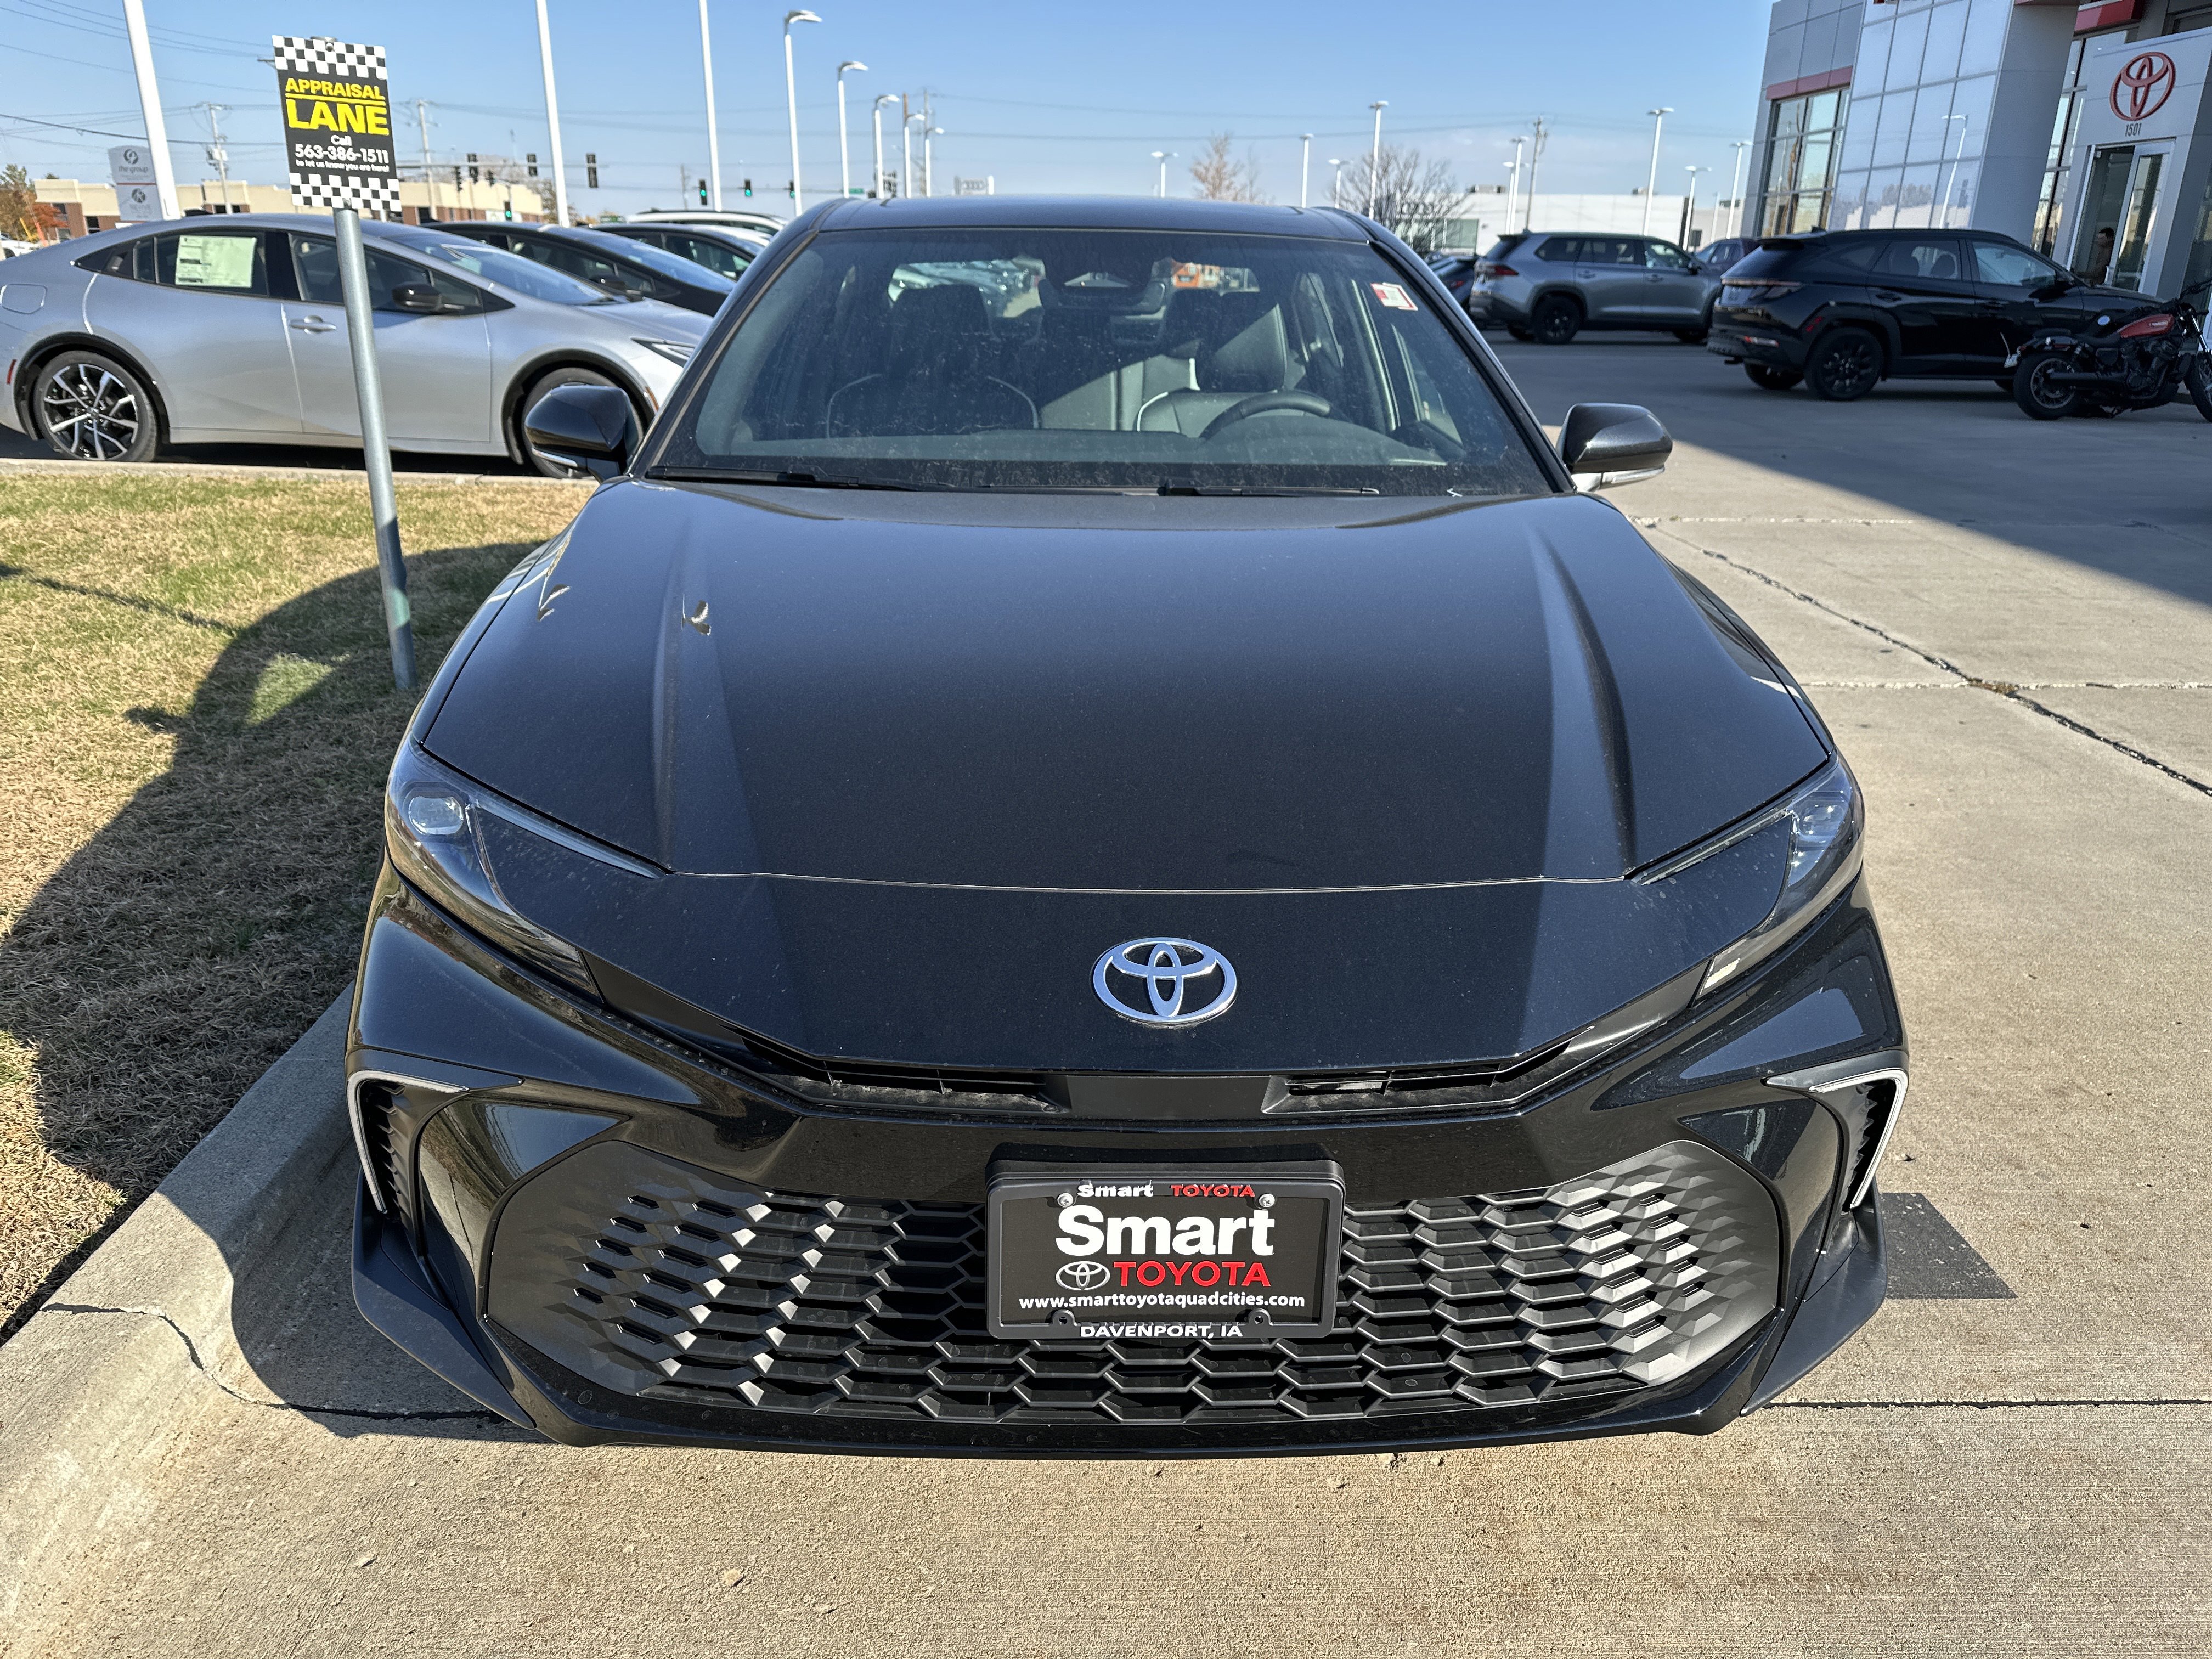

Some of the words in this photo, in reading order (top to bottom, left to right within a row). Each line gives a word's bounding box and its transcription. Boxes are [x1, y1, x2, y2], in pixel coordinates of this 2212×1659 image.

[285, 78, 385, 100] APPRAISAL
[286, 99, 390, 136] LANE
[2125, 122, 2142, 137] 1501
[330, 134, 352, 146] Call
[295, 143, 389, 164] 563-386-1511
[295, 159, 305, 167] to
[325, 160, 345, 170] know
[1077, 1183, 1153, 1197] Smart
[1171, 1184, 1255, 1197] TOYOTA
[1056, 1205, 1275, 1256] Smart
[1113, 1261, 1271, 1287] TOYOTA
[1019, 1291, 1305, 1309] www.smarttoyotaquadcities.com
[1080, 1325, 1214, 1339] DAVENPORT,
[1221, 1325, 1243, 1337] IA
